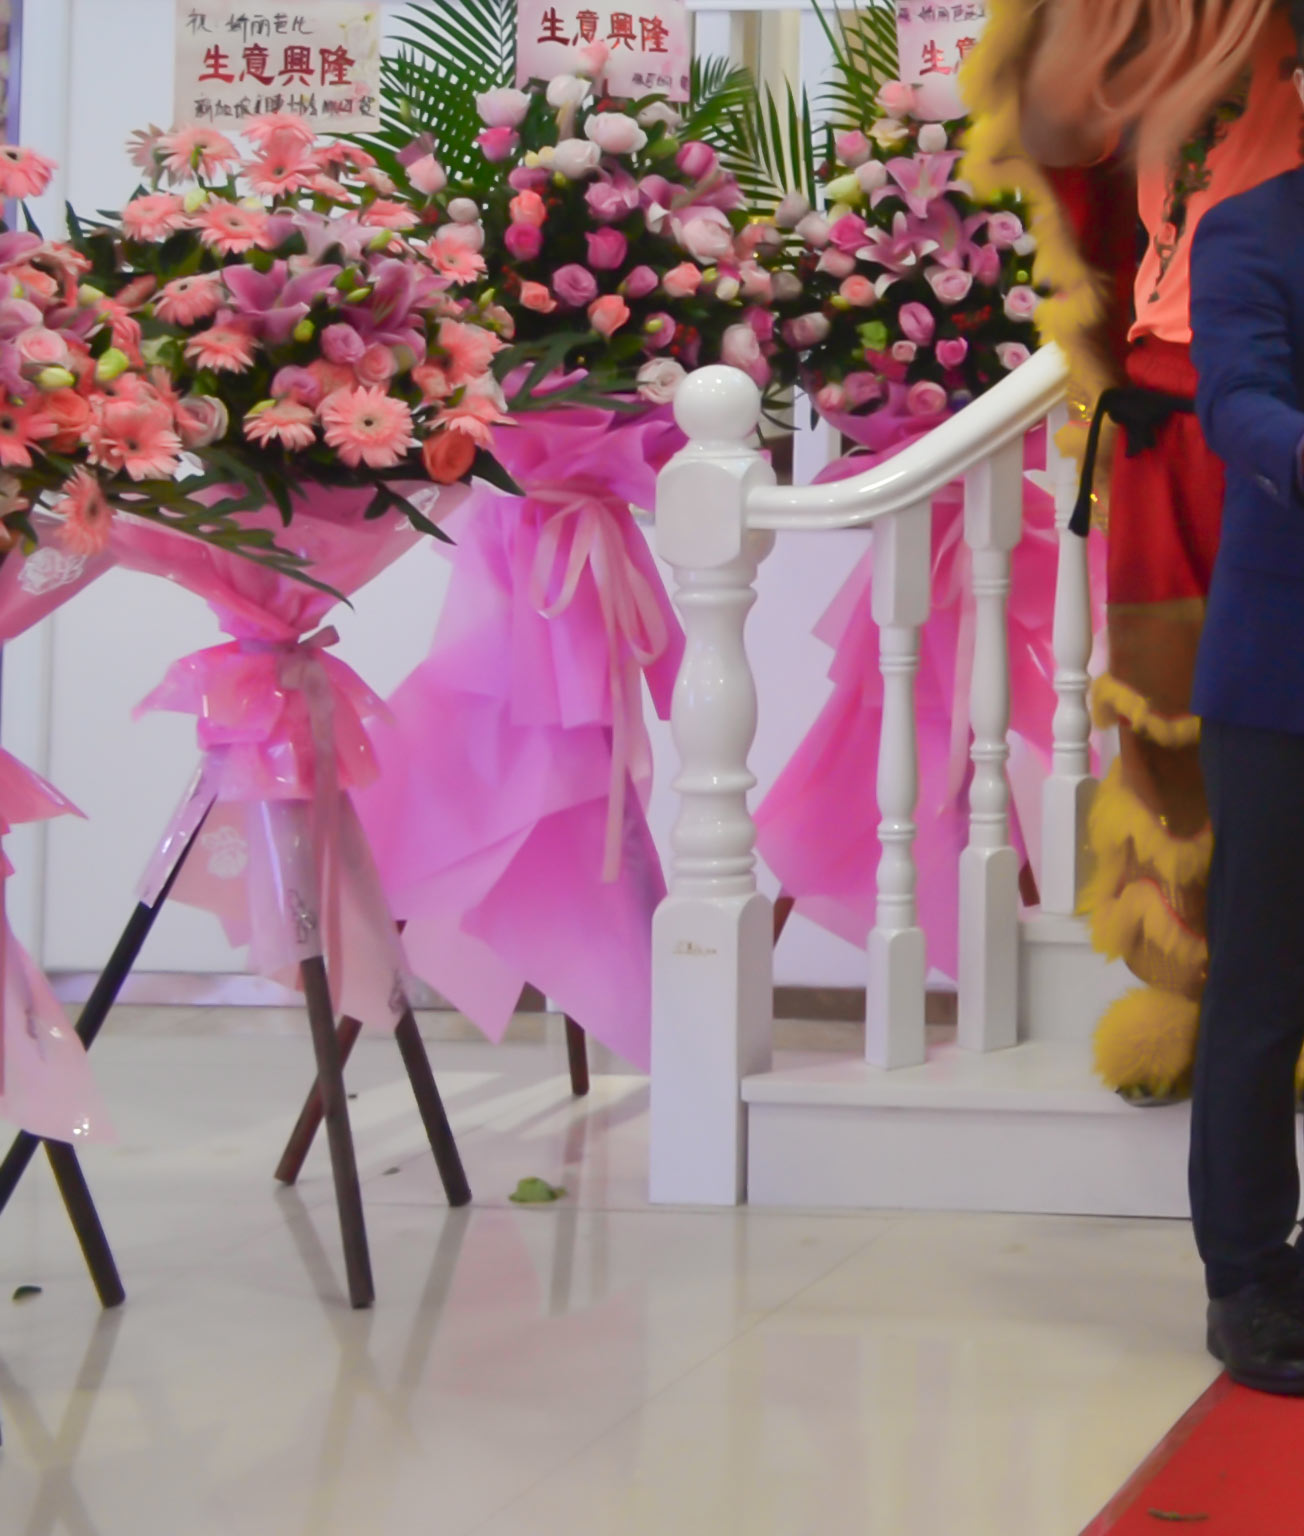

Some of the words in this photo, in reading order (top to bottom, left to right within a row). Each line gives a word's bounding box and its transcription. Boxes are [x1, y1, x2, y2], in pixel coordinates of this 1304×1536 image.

[537, 6, 669, 53] 生意興隆
[198, 42, 356, 87] 生意興隆
